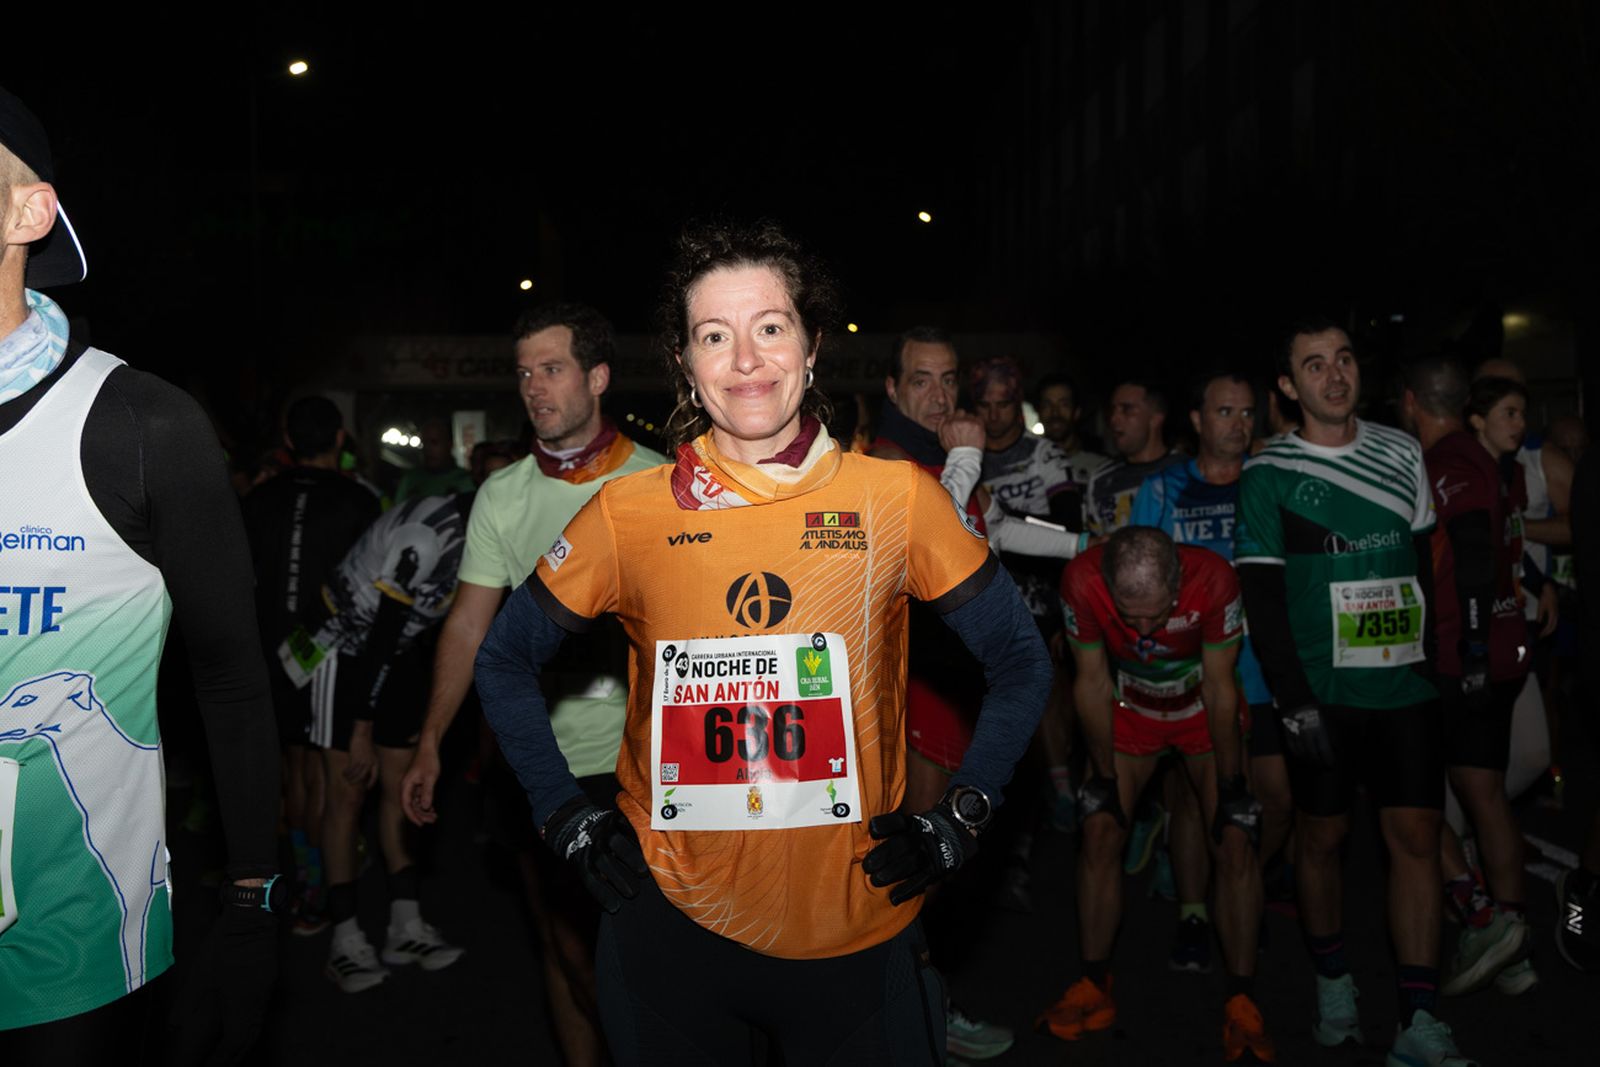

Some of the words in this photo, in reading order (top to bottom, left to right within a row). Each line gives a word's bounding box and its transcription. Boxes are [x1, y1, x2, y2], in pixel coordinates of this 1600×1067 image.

[667, 531, 713, 546] vive
[801, 529, 866, 540] ATLETISMO
[799, 540, 813, 550] AL
[815, 540, 868, 551] ANDALUS
[1355, 609, 1410, 638] 7355
[736, 650, 776, 658] INTERNACIONAL
[675, 656, 689, 671] 43
[691, 658, 751, 678] NOCHE
[756, 657, 778, 675] DE
[673, 683, 709, 704] SAN
[713, 675, 779, 702] ANTÓN
[704, 705, 806, 763] 636
